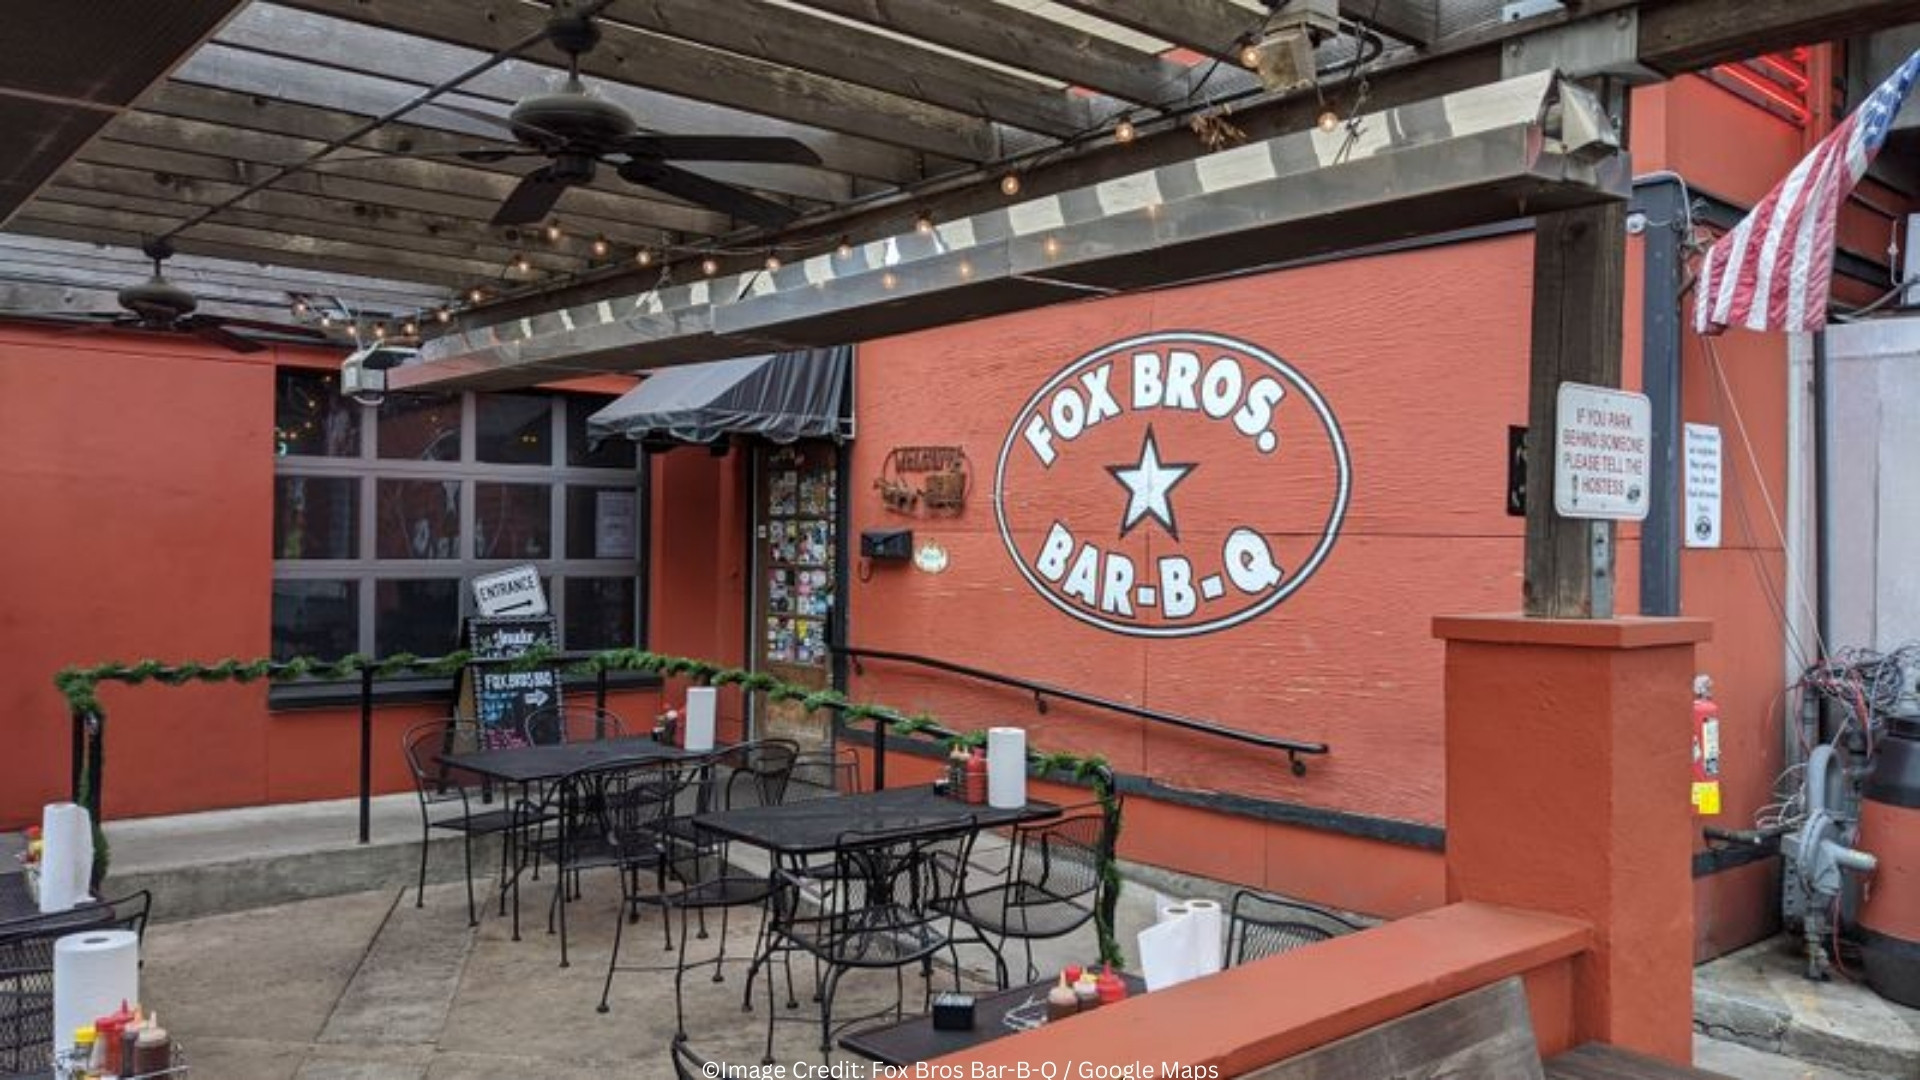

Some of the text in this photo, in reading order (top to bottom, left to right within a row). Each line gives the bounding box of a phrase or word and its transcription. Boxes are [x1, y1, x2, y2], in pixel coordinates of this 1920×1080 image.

[1024, 349, 1286, 469] FOX BROS.
[1577, 408, 1632, 428] IF YOU PARK
[1562, 429, 1644, 453] BEHIND SOMEONE
[1563, 452, 1642, 475] PLEASE TELL THE
[1581, 477, 1624, 496] HOSTESS
[1035, 519, 1284, 619] BAR-B-Q
[480, 575, 536, 601] ENTRANCE
